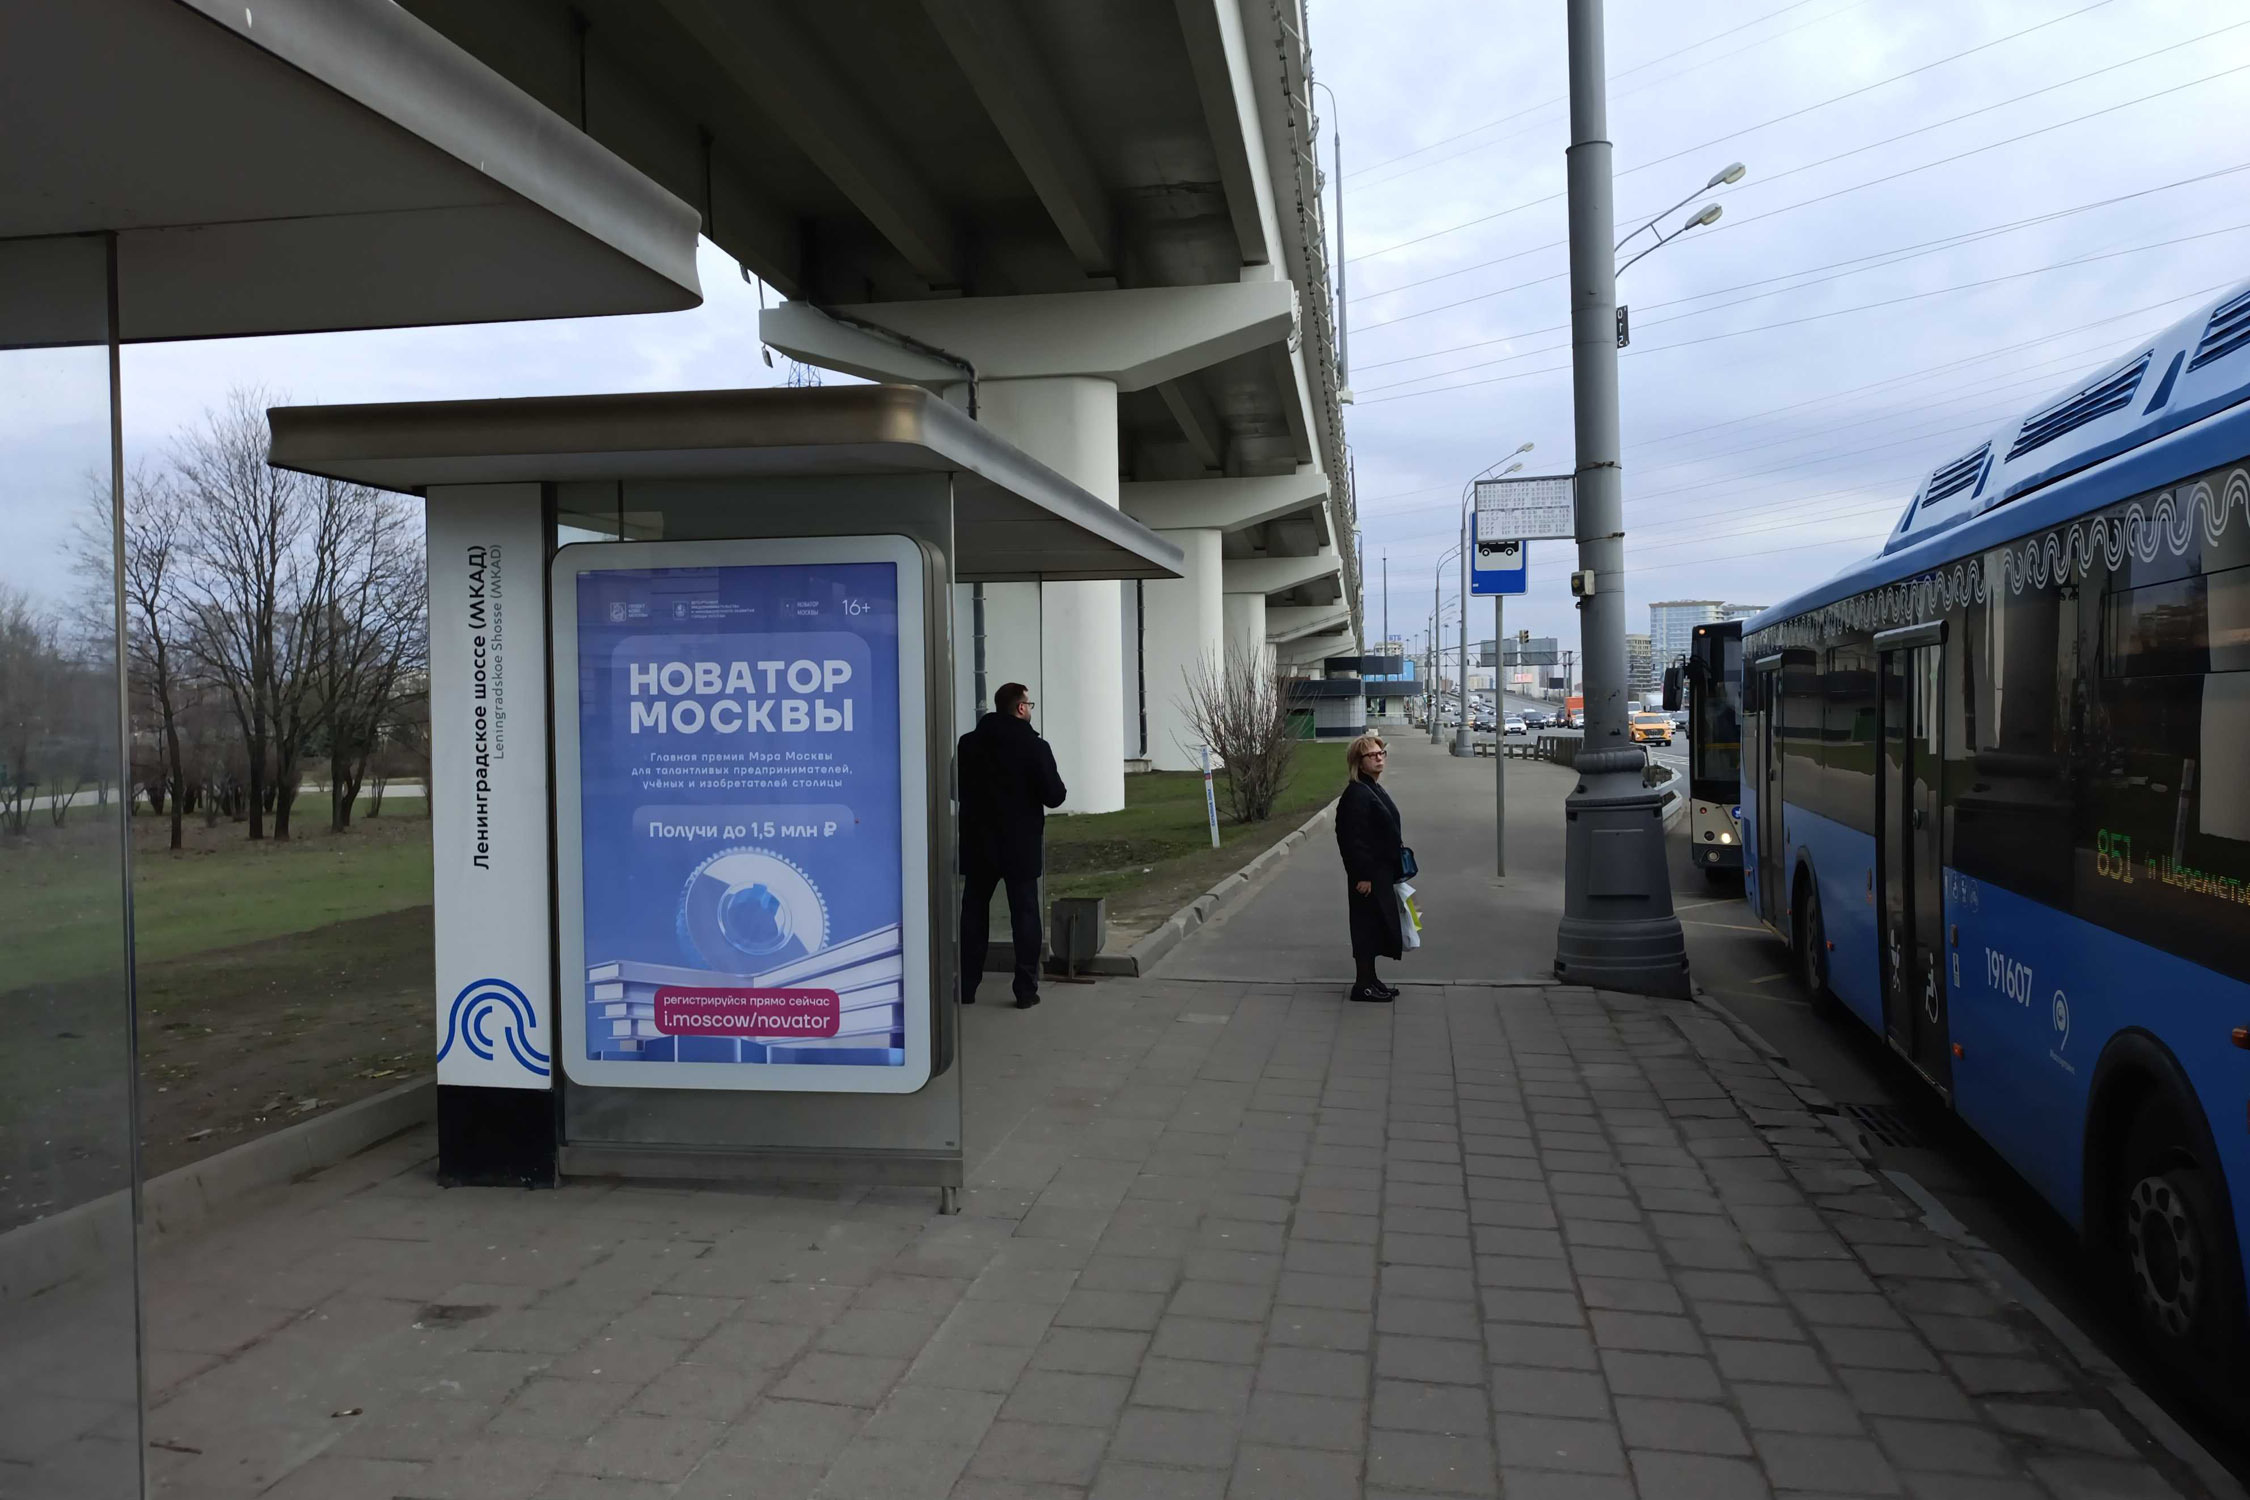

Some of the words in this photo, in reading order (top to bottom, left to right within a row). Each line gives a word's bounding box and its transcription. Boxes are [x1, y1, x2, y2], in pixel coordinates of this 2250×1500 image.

[467, 545, 487, 629] (МКАД)
[490, 544, 503, 599] (MKAD)
[842, 599, 871, 616] 16+
[490, 602, 503, 651] Shosse
[473, 635, 487, 700] шоссе
[629, 660, 853, 696] НОВАТОР
[491, 655, 506, 760] Leningradskoe
[630, 698, 853, 734] МОСКВЫ
[631, 767, 651, 776] для
[656, 766, 729, 775] талантливых
[734, 764, 853, 776] предпринимателей,
[650, 752, 697, 762] Главная
[701, 753, 745, 763] премия
[749, 751, 781, 763] Мэра
[785, 751, 833, 761] Москвы
[473, 705, 491, 870] Ленинградское
[643, 778, 684, 789] учёных
[688, 780, 695, 788] и
[700, 777, 788, 789] изобретателей
[792, 779, 843, 789] столицы
[649, 822, 718, 841] Получи
[723, 825, 746, 840] до
[751, 822, 776, 840] 1,5
[781, 825, 818, 838] млн
[823, 821, 837, 838] ₽
[2097, 829, 2134, 884] 851
[1985, 946, 2033, 1007] 191607
[663, 995, 747, 1008] регистрируйся
[750, 996, 786, 1007] прямо
[789, 995, 830, 1007] сейчас
[663, 1010, 831, 1029] i.moscow/novator
